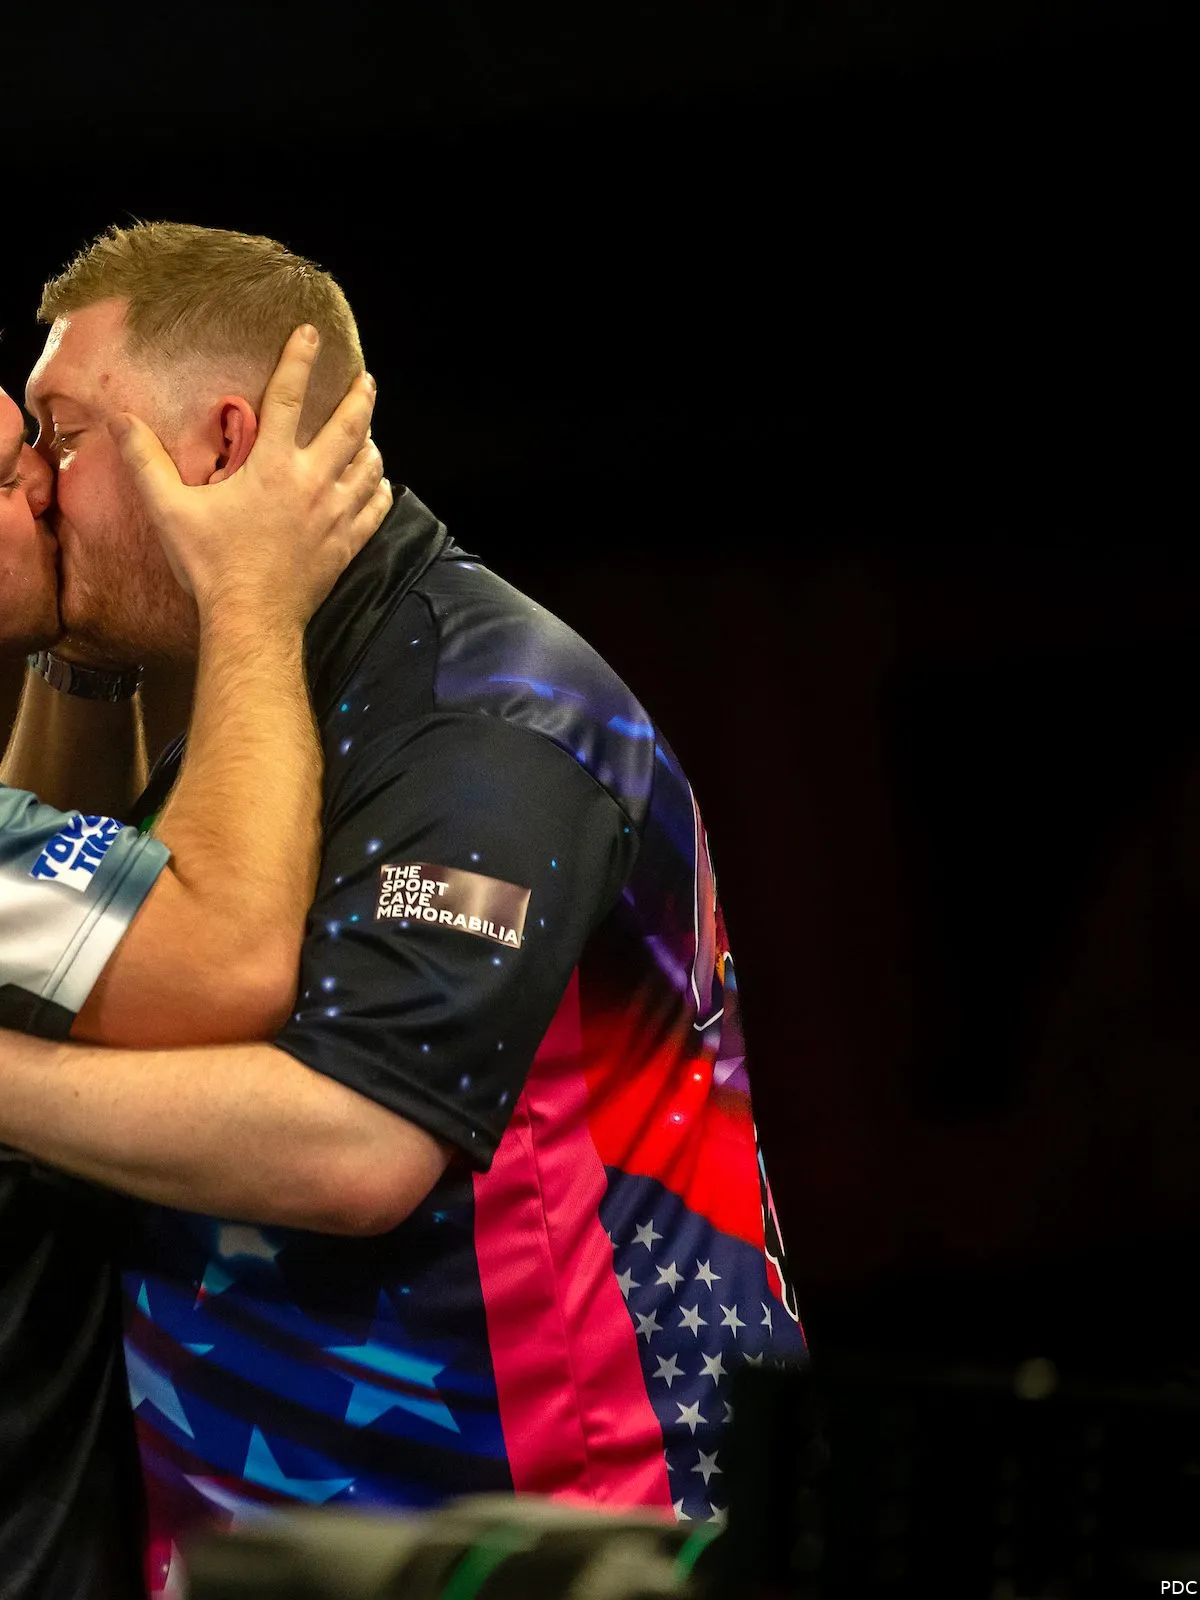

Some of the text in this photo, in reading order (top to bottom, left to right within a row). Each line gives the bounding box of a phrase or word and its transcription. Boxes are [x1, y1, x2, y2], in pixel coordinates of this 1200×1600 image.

[384, 865, 422, 880] THE
[381, 879, 448, 896] SPORT
[379, 892, 431, 906] CAVE
[376, 904, 519, 945] MEMORABILIA
